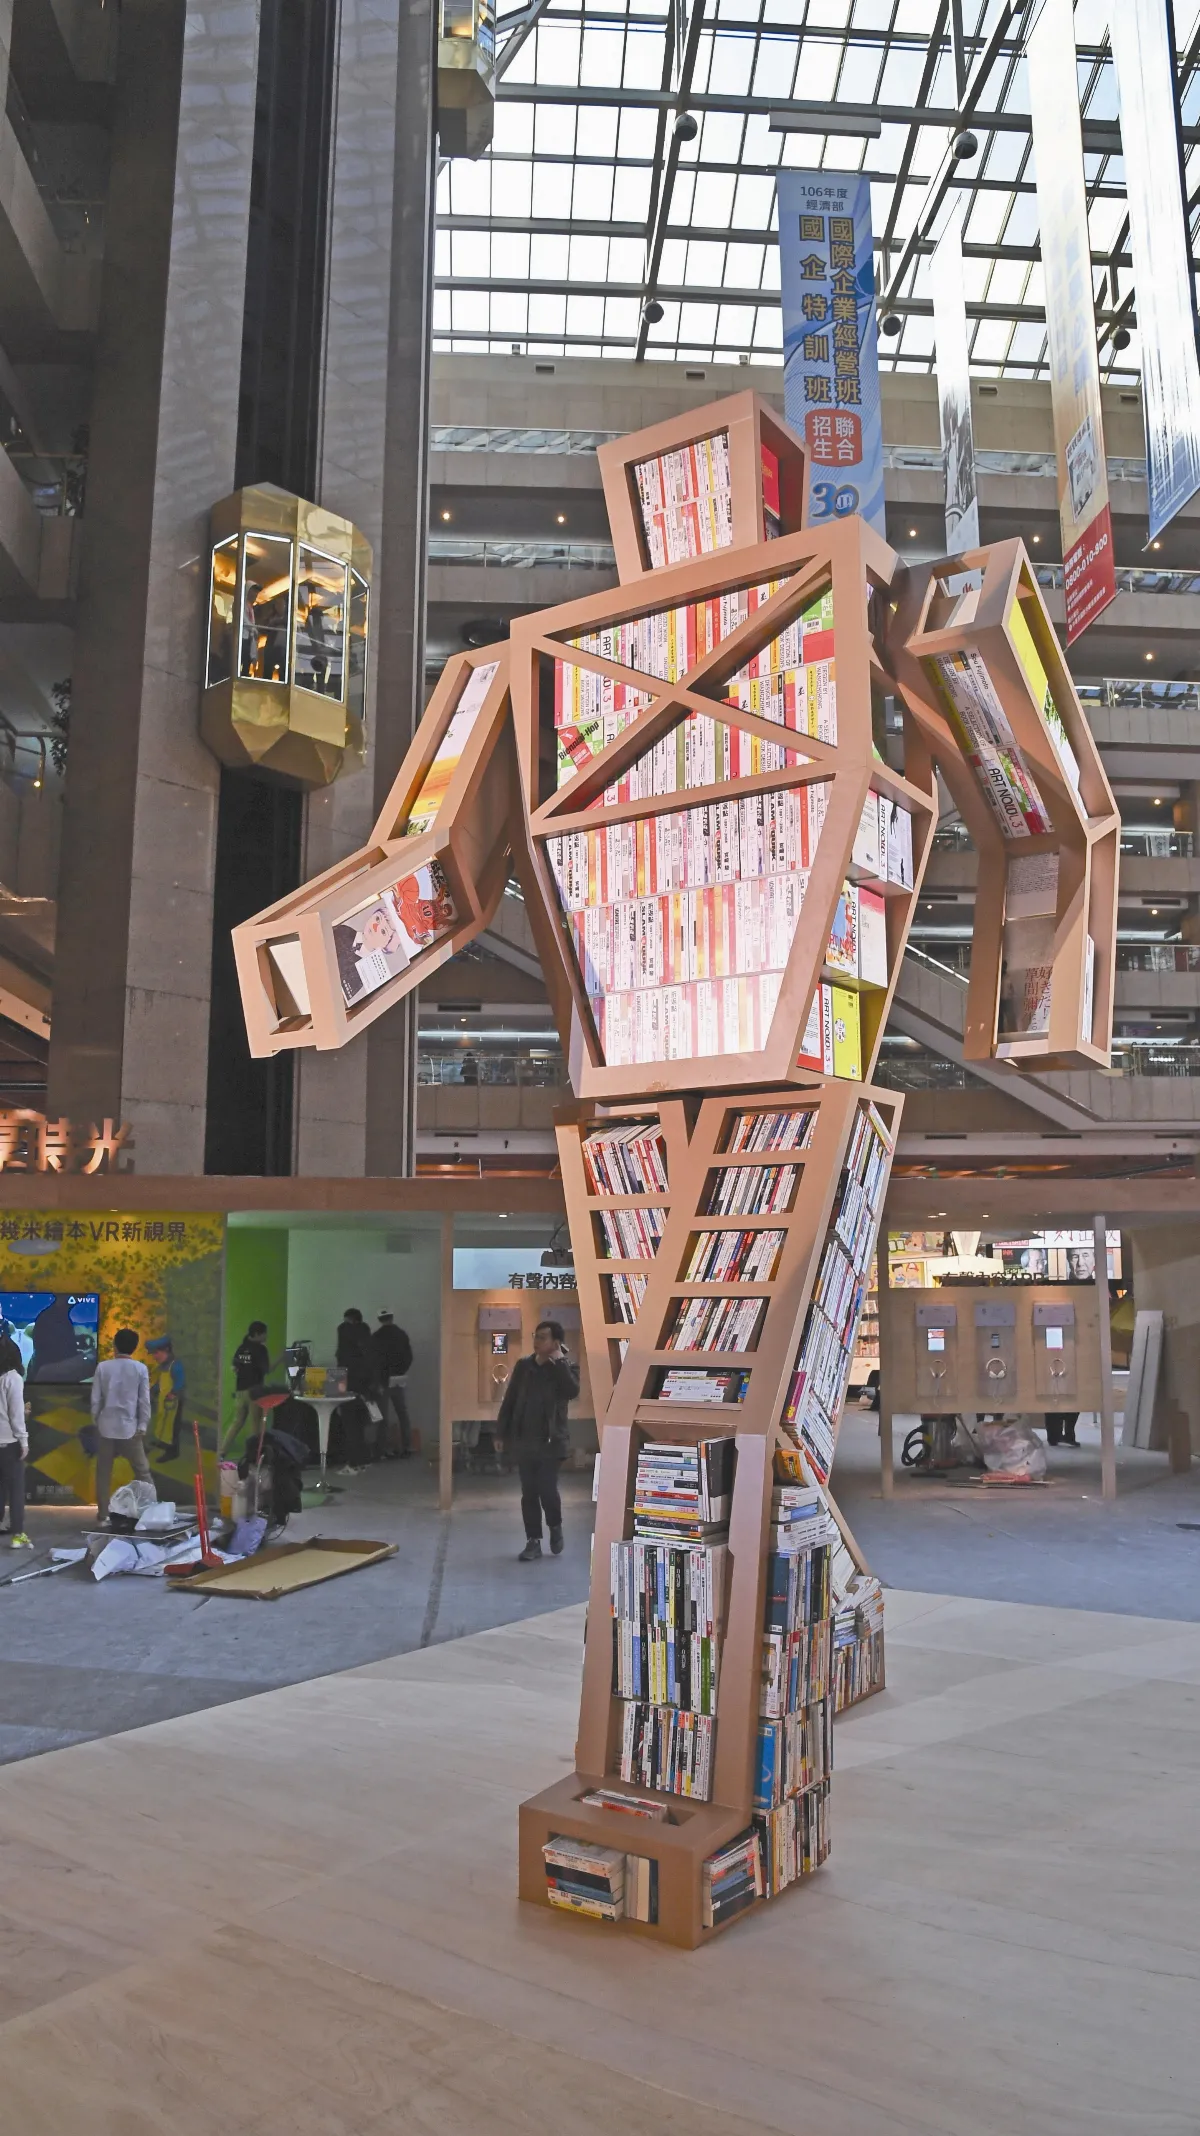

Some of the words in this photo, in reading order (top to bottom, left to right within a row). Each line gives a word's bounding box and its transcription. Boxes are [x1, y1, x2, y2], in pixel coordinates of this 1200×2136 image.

[800, 186, 848, 199] 106年度
[806, 199, 844, 212] 經濟部
[799, 214, 833, 404] 國企特訓班
[828, 216, 862, 405] 國際企業經營班
[812, 416, 833, 460] 招生
[834, 417, 855, 461] 聯合
[602, 635, 611, 657] ART
[558, 721, 600, 761] Biennial-Hop
[988, 768, 1004, 787] ART
[421, 905, 432, 917] 10
[1, 1220, 187, 1243] 幾米繪本VR新視界
